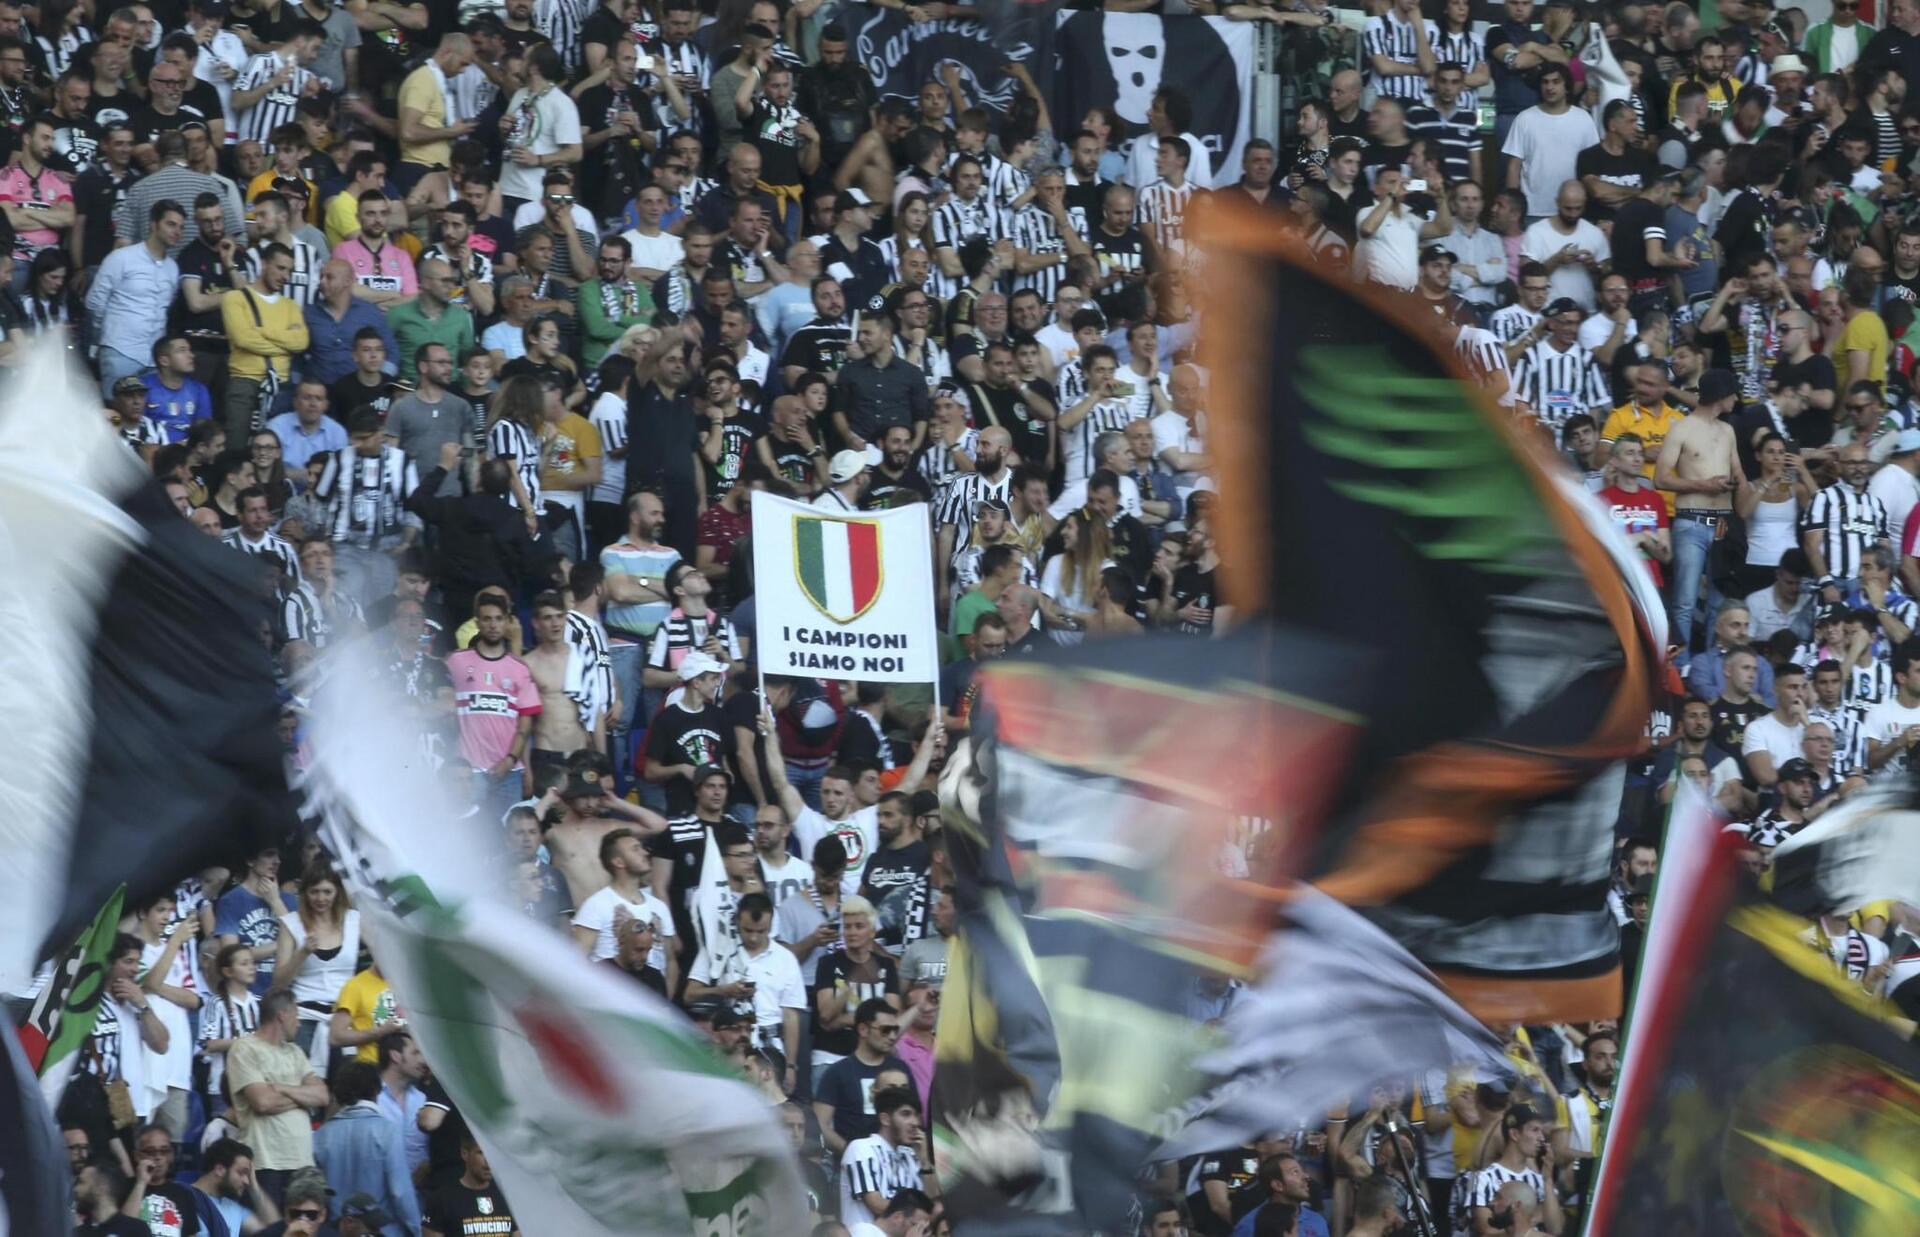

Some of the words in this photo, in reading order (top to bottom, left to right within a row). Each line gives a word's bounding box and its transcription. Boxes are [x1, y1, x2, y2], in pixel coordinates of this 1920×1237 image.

[785, 626, 790, 641] I
[796, 628, 908, 649] CAMPIONI
[789, 652, 857, 672] SIAMO
[863, 657, 904, 673] NOI
[471, 695, 508, 713] Jeep
[869, 866, 917, 888] Carlsberg
